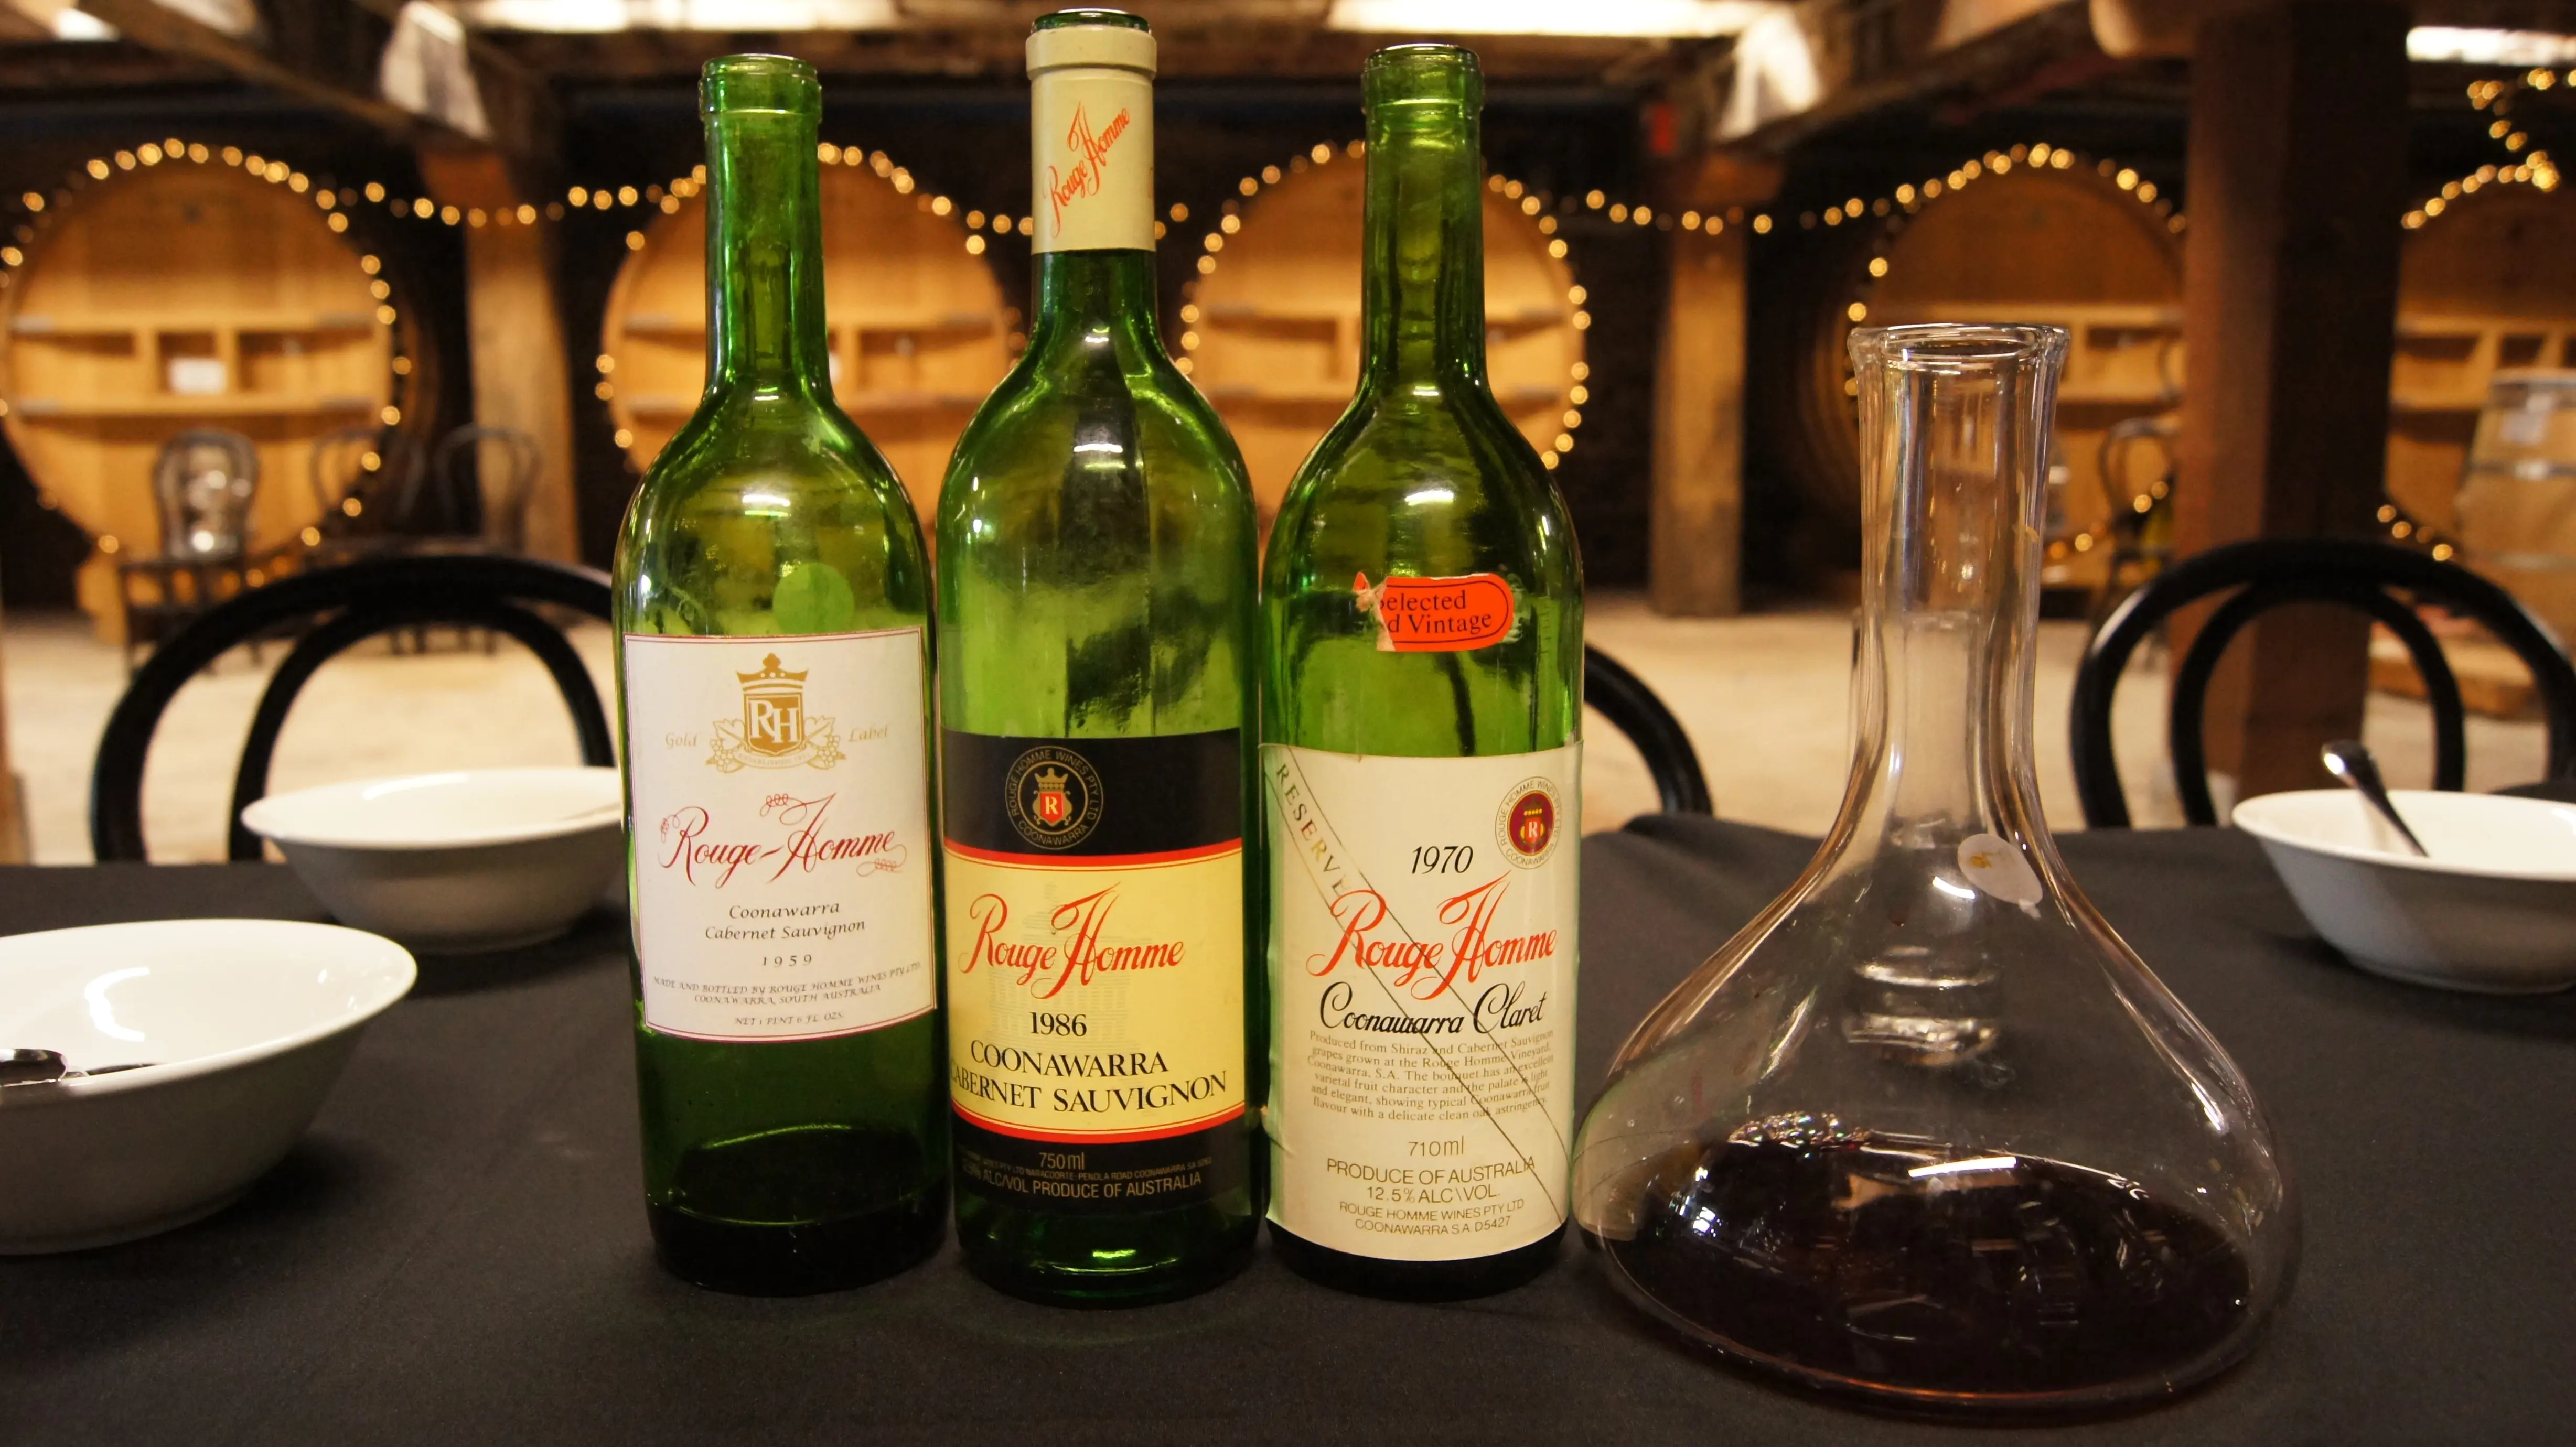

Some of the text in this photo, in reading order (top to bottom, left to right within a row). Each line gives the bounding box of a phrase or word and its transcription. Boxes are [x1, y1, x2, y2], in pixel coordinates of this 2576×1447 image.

[1044, 101, 1130, 238] Rouge Homme
[1408, 614, 1491, 634] Vintage
[749, 699, 800, 744] RH
[665, 725, 889, 748] Gold Label
[1008, 750, 1099, 820] ROUGE HOMME WINES PTY LTD
[1045, 796, 1058, 814] R
[1498, 809, 1508, 846] ROUGE
[1506, 780, 1534, 806] HOMME
[1018, 820, 1089, 845] COONAWARRA
[1276, 764, 1351, 897] RESERVE
[1528, 822, 1538, 838] R
[1412, 845, 1474, 874] 1970
[729, 902, 840, 919] Coonawarra
[705, 921, 866, 940] Cabernet Sauvignon
[958, 881, 1186, 999] Rouge Homme
[1306, 870, 1558, 1000] Rouge Homme
[679, 982, 699, 991] AND
[702, 985, 748, 994] BOTTLED
[769, 984, 807, 994] ROUGE
[812, 978, 853, 990] HOMME
[779, 994, 817, 1004] SOUTH
[822, 984, 881, 1000] AUSTRALIA
[1320, 981, 1547, 1034] Coonawarra Claret
[767, 1016, 793, 1025] PINT
[1030, 1011, 1087, 1037] 1986
[1310, 1030, 1553, 1054] Produced from Shiraz and Cabernet Sauvignon
[971, 1040, 1169, 1077] COONAWARRA
[1312, 1047, 1343, 1060] grapes
[1346, 1054, 1380, 1064] grown
[1384, 1058, 1394, 1066] at
[1400, 1057, 1418, 1067] the
[1423, 1057, 1459, 1070] Rouge
[1465, 1055, 1506, 1066] Homme
[1375, 1068, 1399, 1080] S.A.
[1405, 1071, 1428, 1081] The
[1433, 1071, 1479, 1084] bouquet
[1484, 1068, 1500, 1078] has
[1504, 1066, 1515, 1075] an
[1518, 1054, 1554, 1071] excellent
[950, 1058, 1227, 1113] CABERNET SAUVIGNON
[1315, 1073, 1350, 1087] varietal
[1355, 1079, 1378, 1091] fruit
[1382, 1084, 1439, 1094] character
[1443, 1085, 1463, 1094] and
[1469, 1083, 1484, 1093] the
[1488, 1078, 1518, 1092] palate
[1531, 1069, 1548, 1082] light
[1312, 1081, 1550, 1110] and elegant, showing typical Coonawarra fruit
[1313, 1096, 1347, 1114] flavour
[1351, 1105, 1374, 1118] with
[1388, 1110, 1434, 1121] delicate
[1439, 1111, 1468, 1120] clean
[1473, 1107, 1491, 1118] oak
[1327, 1156, 1536, 1185] PRODUCE OF AUSTRALIA
[1033, 1180, 1099, 1198] PRODUCE
[1104, 1183, 1122, 1197] OF
[1126, 1172, 1201, 1196] AUSTRALIA
[1367, 1186, 1415, 1203] 12.5%
[1339, 1198, 1524, 1221] ROUGE HOMME WINES PTY LTD
[1355, 1219, 1448, 1235] COONAWARRA
[1475, 1216, 1511, 1232] D5427
